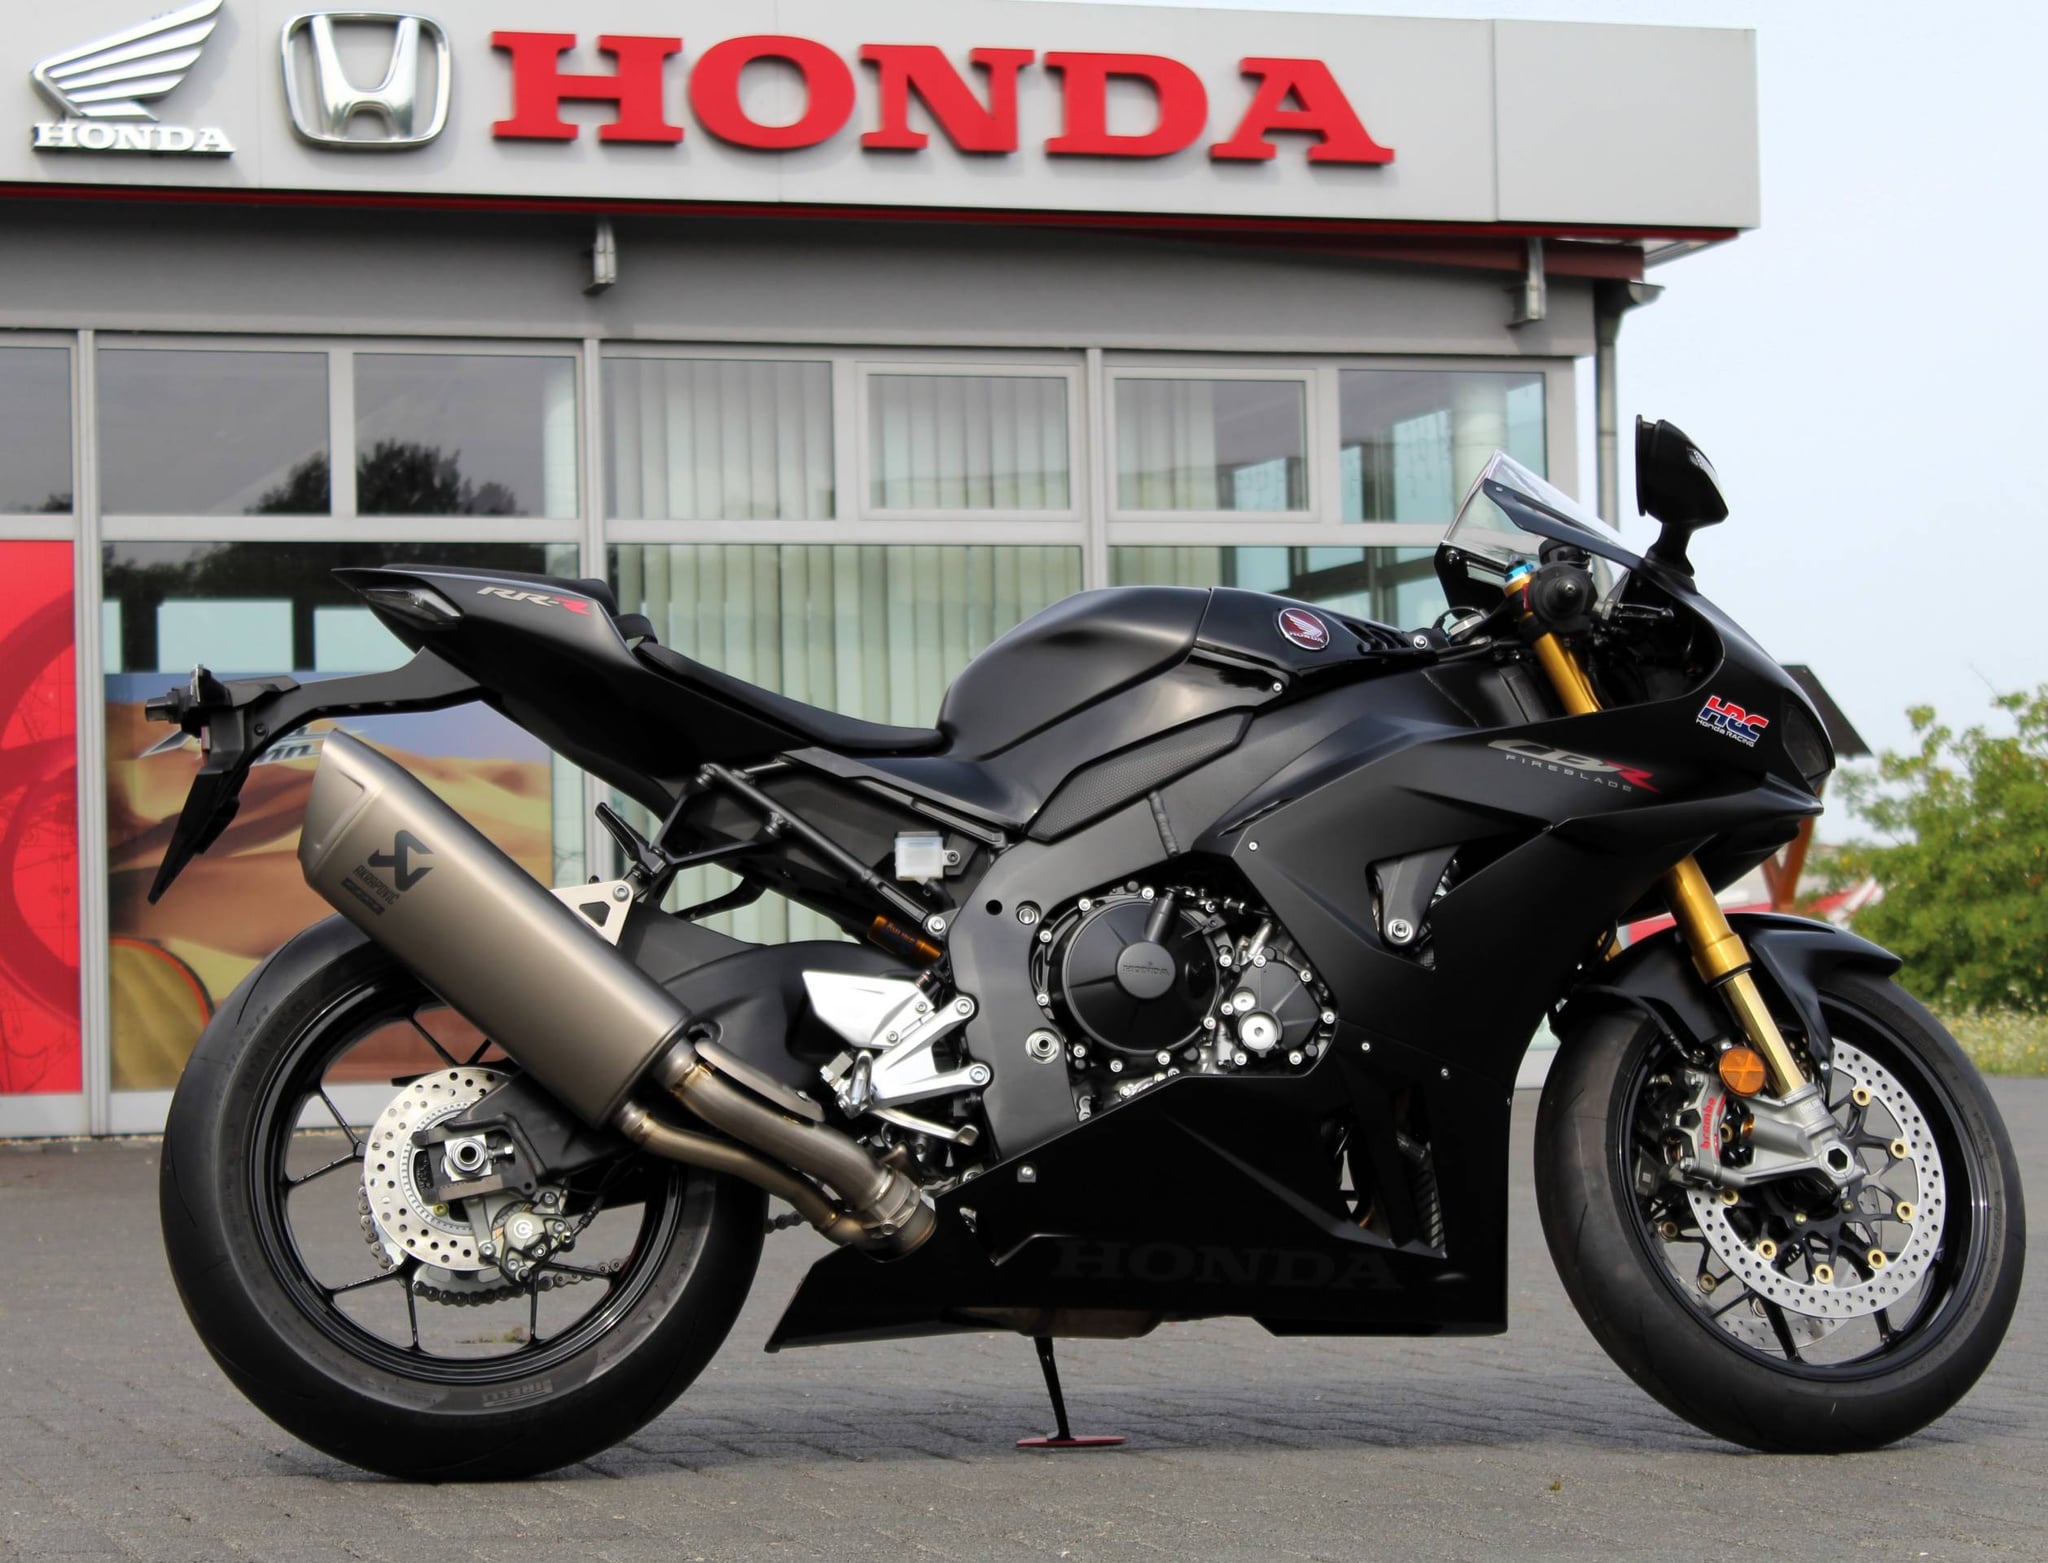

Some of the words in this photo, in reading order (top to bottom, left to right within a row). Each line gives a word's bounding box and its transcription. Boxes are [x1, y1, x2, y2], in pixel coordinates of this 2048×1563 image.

[491, 30, 1395, 163] HONDA
[34, 121, 236, 153] HONDA
[1696, 717, 1726, 735] Honda
[1725, 730, 1755, 748] RACING
[1698, 695, 1770, 743] HRC
[1487, 738, 1662, 793] CBR
[1505, 752, 1633, 793] FIREBLADE
[1699, 1096, 1717, 1150] brembo
[1049, 1238, 1404, 1290] HONDA
